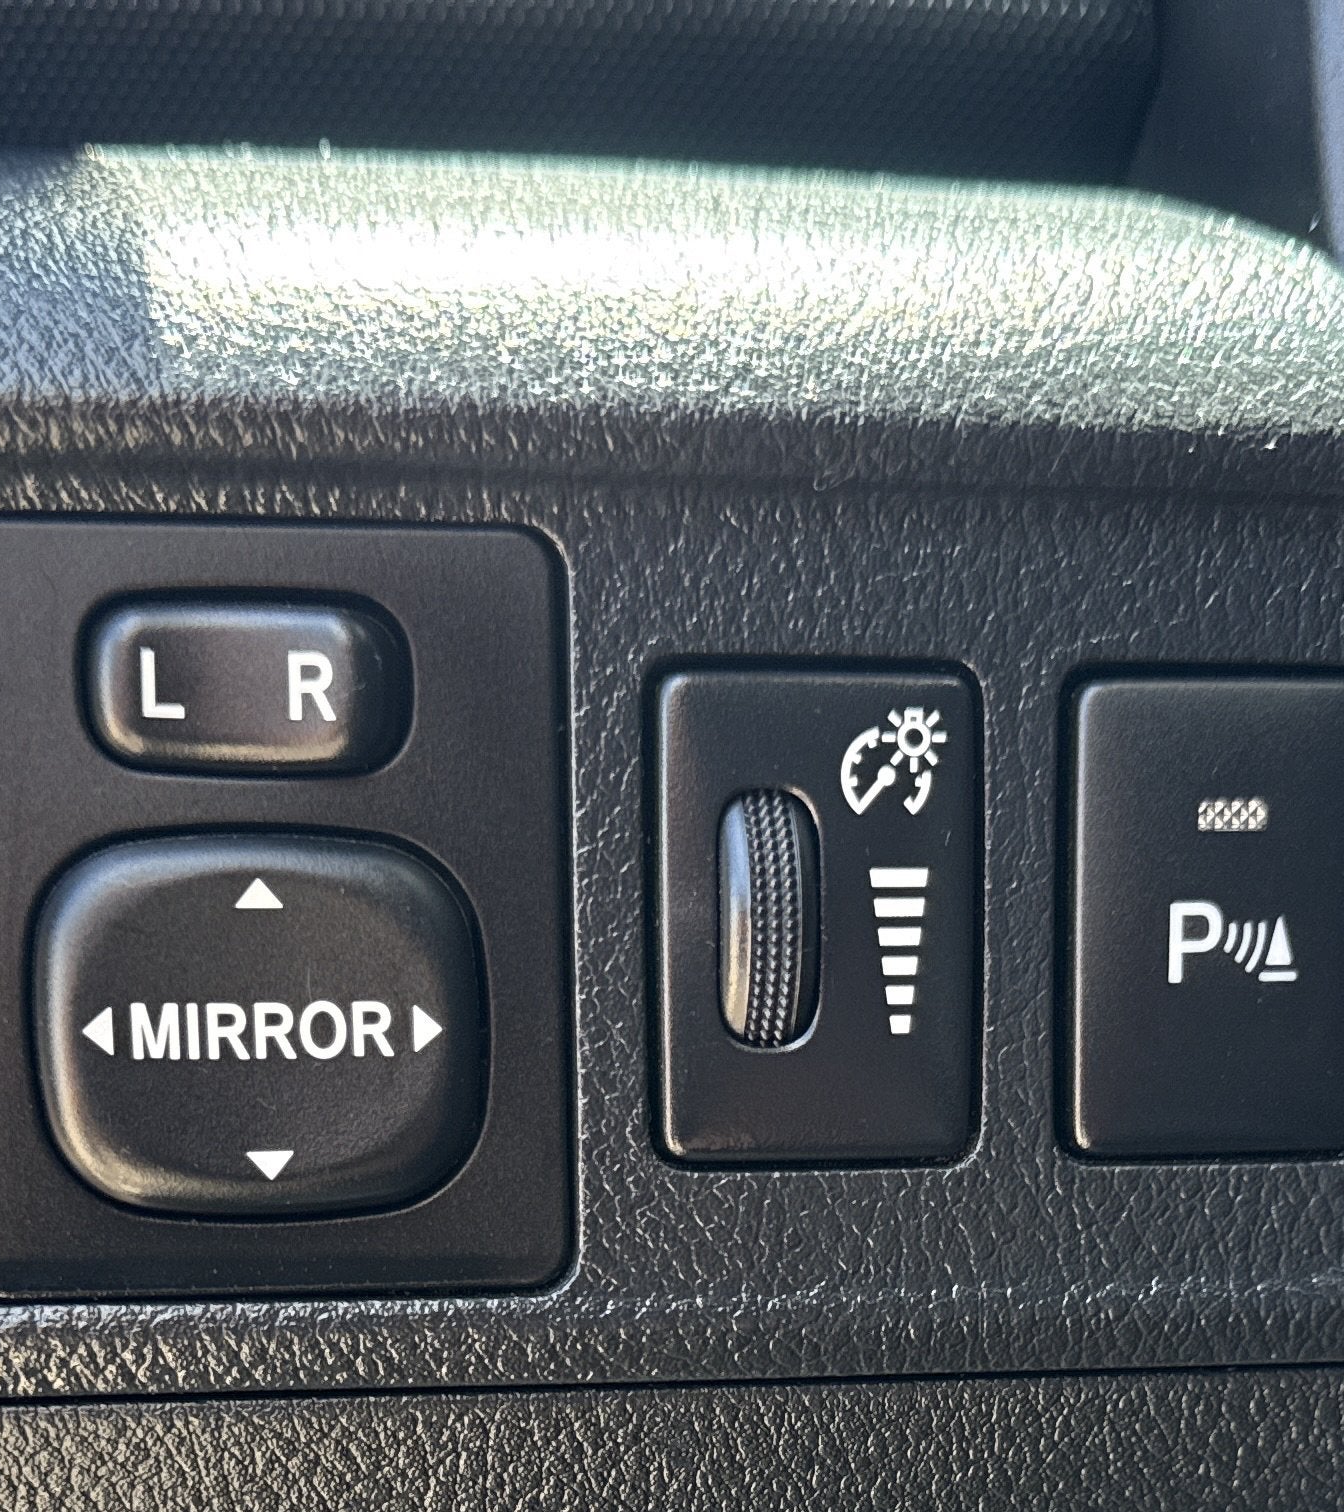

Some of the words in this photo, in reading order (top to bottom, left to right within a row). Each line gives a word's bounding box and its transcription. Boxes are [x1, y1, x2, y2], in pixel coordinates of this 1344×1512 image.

[140, 648, 185, 719] L
[287, 650, 337, 721] R
[1168, 901, 1223, 983] P
[130, 1000, 394, 1060] MIRROR
